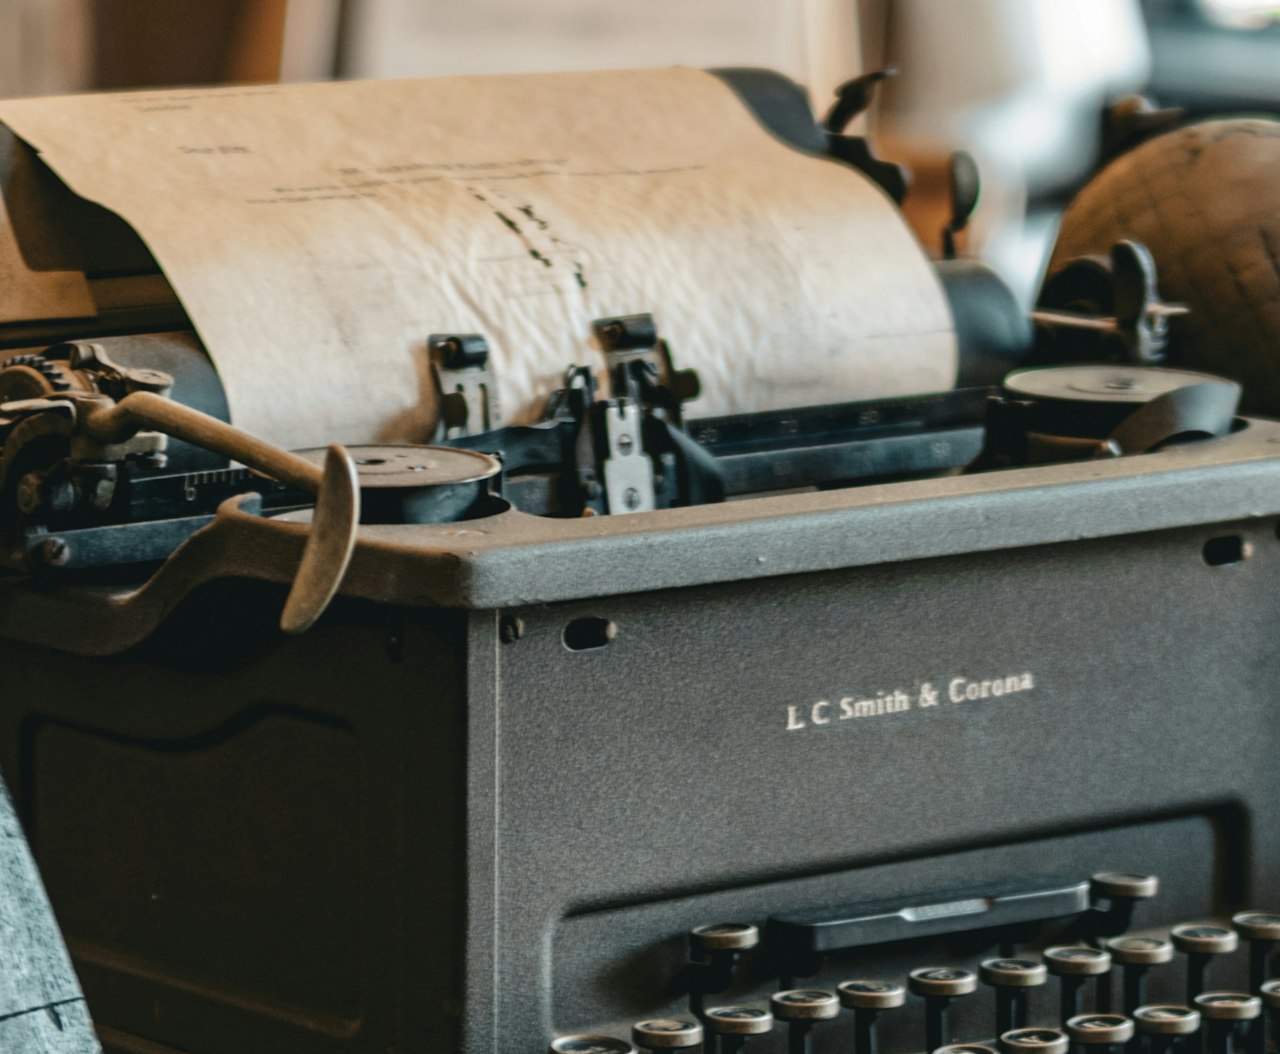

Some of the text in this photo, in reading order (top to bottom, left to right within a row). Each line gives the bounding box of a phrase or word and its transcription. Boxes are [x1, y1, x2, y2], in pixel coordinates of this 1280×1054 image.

[786, 671, 1034, 730] L C Smith & Corona
